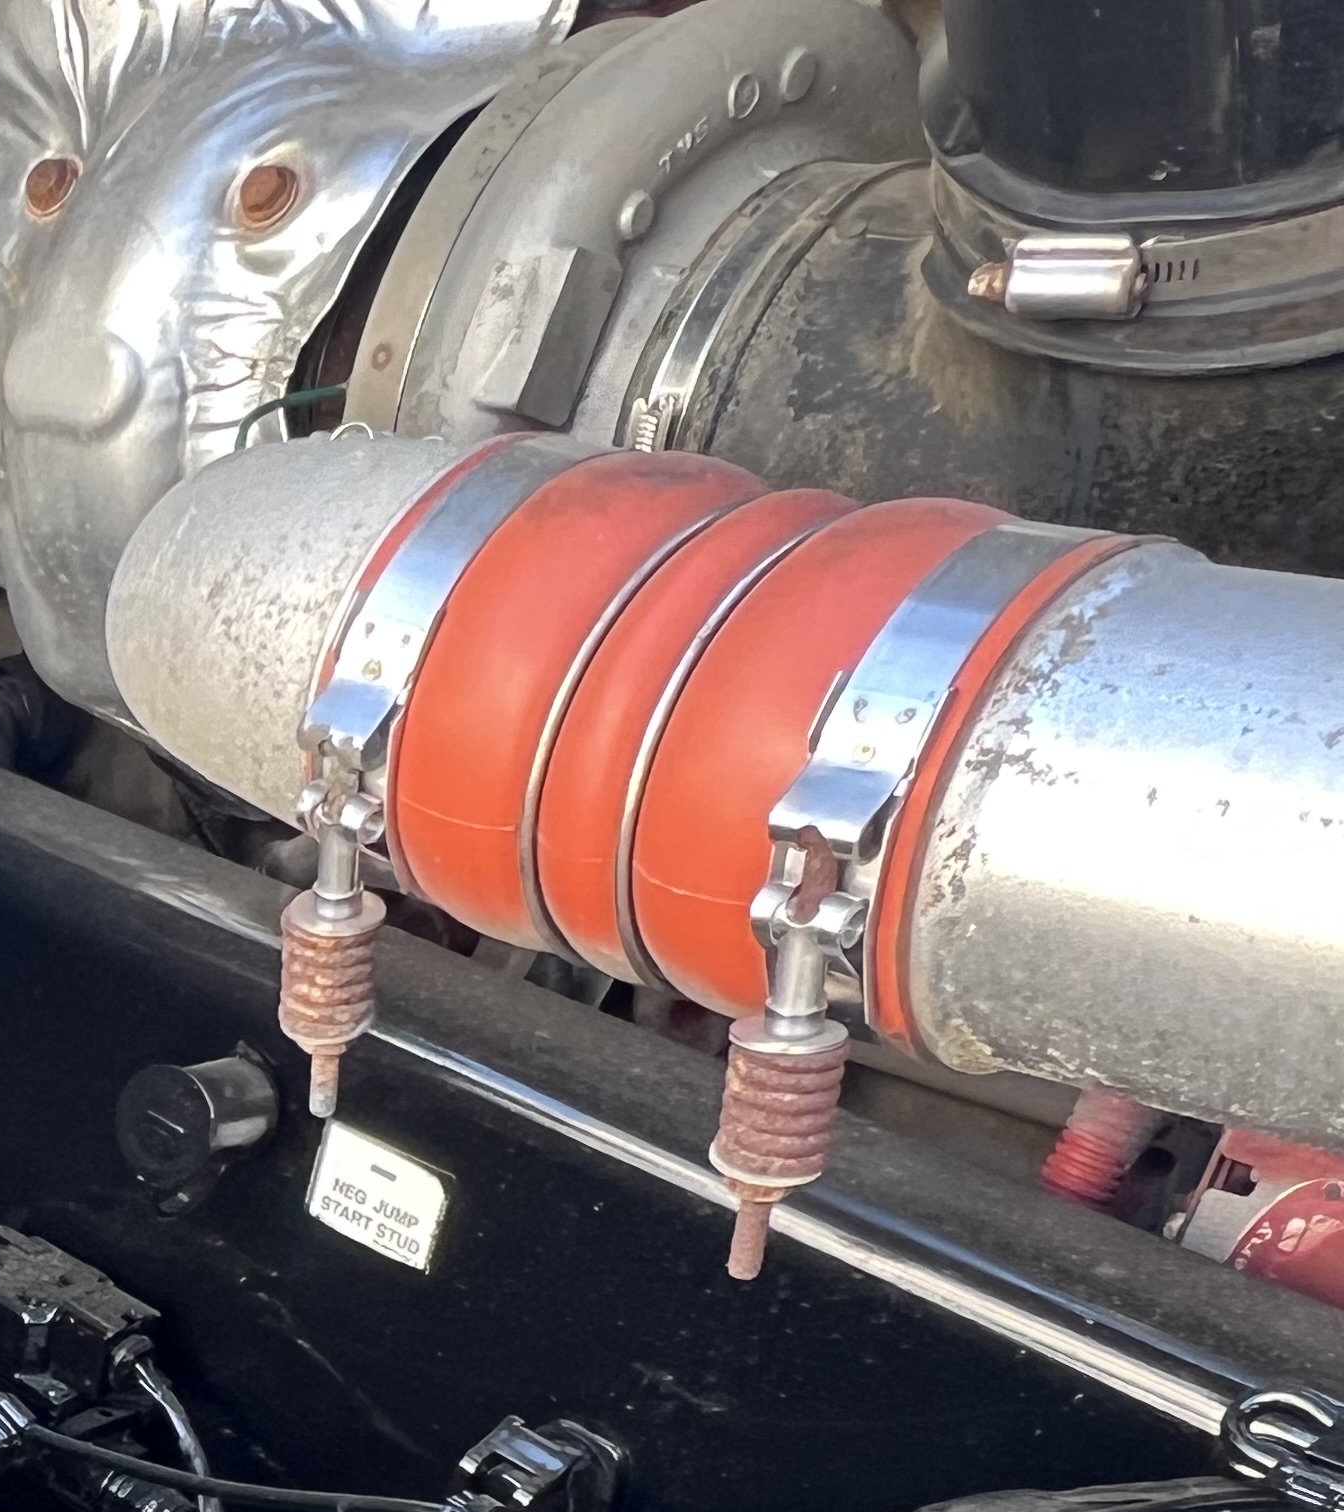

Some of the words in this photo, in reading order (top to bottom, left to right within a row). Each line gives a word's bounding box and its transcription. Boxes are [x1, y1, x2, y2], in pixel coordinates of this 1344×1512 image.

[321, 1195, 373, 1231] START
[375, 1222, 420, 1256] STUD
[332, 1177, 367, 1205] NEG
[373, 1199, 420, 1229] JUMP
